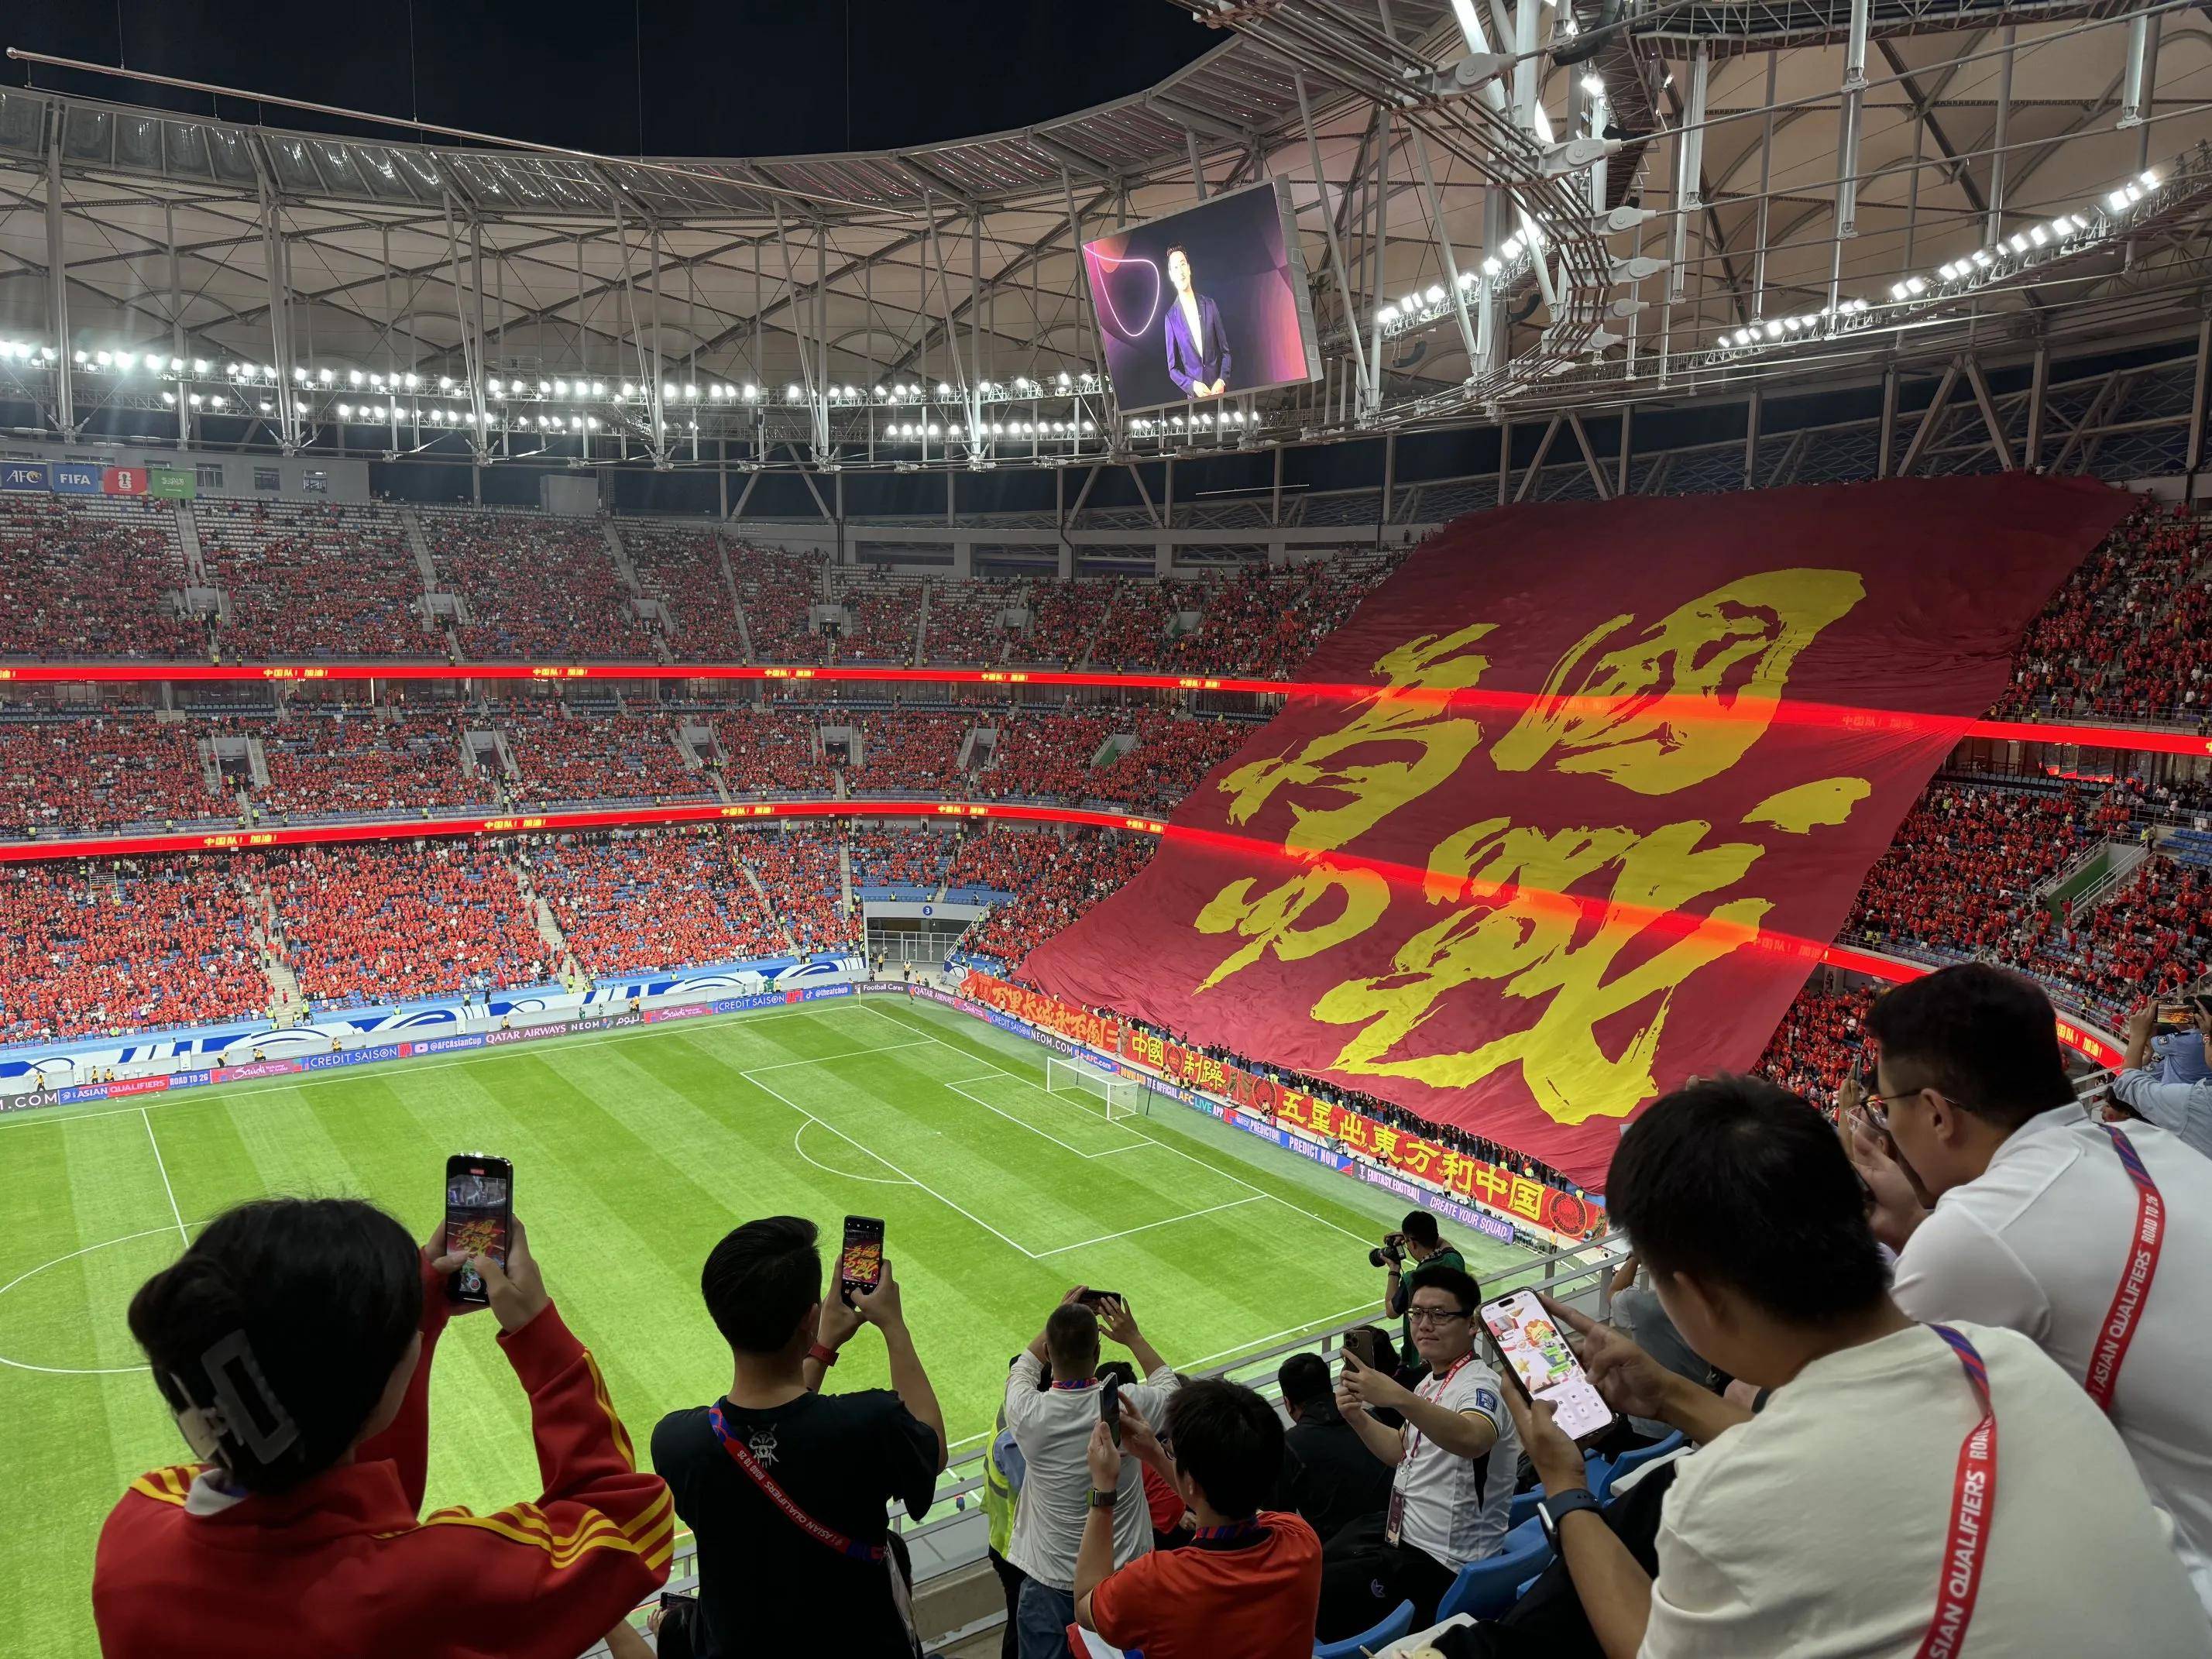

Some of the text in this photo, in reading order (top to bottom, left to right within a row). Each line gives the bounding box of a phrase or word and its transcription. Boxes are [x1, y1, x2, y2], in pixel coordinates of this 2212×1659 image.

[6, 469, 42, 483] AFC
[60, 473, 91, 485] FIFA
[863, 983, 887, 991] Football
[914, 986, 933, 999] QATAR
[934, 991, 955, 1005] AIRWAYS
[719, 994, 785, 1012] CREDIT SAISON
[486, 1024, 566, 1044] QATAR AIRWAYS
[571, 1020, 599, 1031] NEOM
[991, 1014, 1031, 1038] CREDIT SAISON
[430, 1037, 482, 1051] @AFCAsianCup
[1030, 1029, 1073, 1055] NEOM.COM
[310, 1047, 397, 1067] CREDIT SAISON
[232, 1064, 266, 1080] Saudi
[77, 1087, 108, 1098] ASIAN
[110, 1080, 165, 1093] QUALIFIERS
[170, 1077, 187, 1086] ROAD
[189, 1075, 198, 1084] TO
[199, 1073, 208, 1082] 26
[1156, 1080, 1178, 1100] OFFICIAL
[1178, 1091, 1194, 1105] AFC
[1194, 1097, 1212, 1113] LIVE
[1212, 1104, 1224, 1118] APP
[1289, 1135, 1338, 1168] PREDICT NOW
[1367, 1167, 1392, 1189] FANTASY
[1393, 1179, 1420, 1203] FOOTBALL
[1429, 1196, 1509, 1238] CREATE YOUR SQUAD
[2145, 1205, 2159, 1218] TO
[2141, 1218, 2158, 1245] ROAD
[2108, 1250, 2151, 1338] QUALIFIERS
[2093, 1339, 2120, 1389] ASIAN
[737, 1450, 747, 1460] 26
[744, 1458, 753, 1468] TO
[764, 1481, 807, 1523] QUALIFIERS
[1949, 1470, 1987, 1599] QUALIFIERS
[1970, 1429, 1990, 1460] ROAD
[806, 1521, 833, 1540] ASIAN
